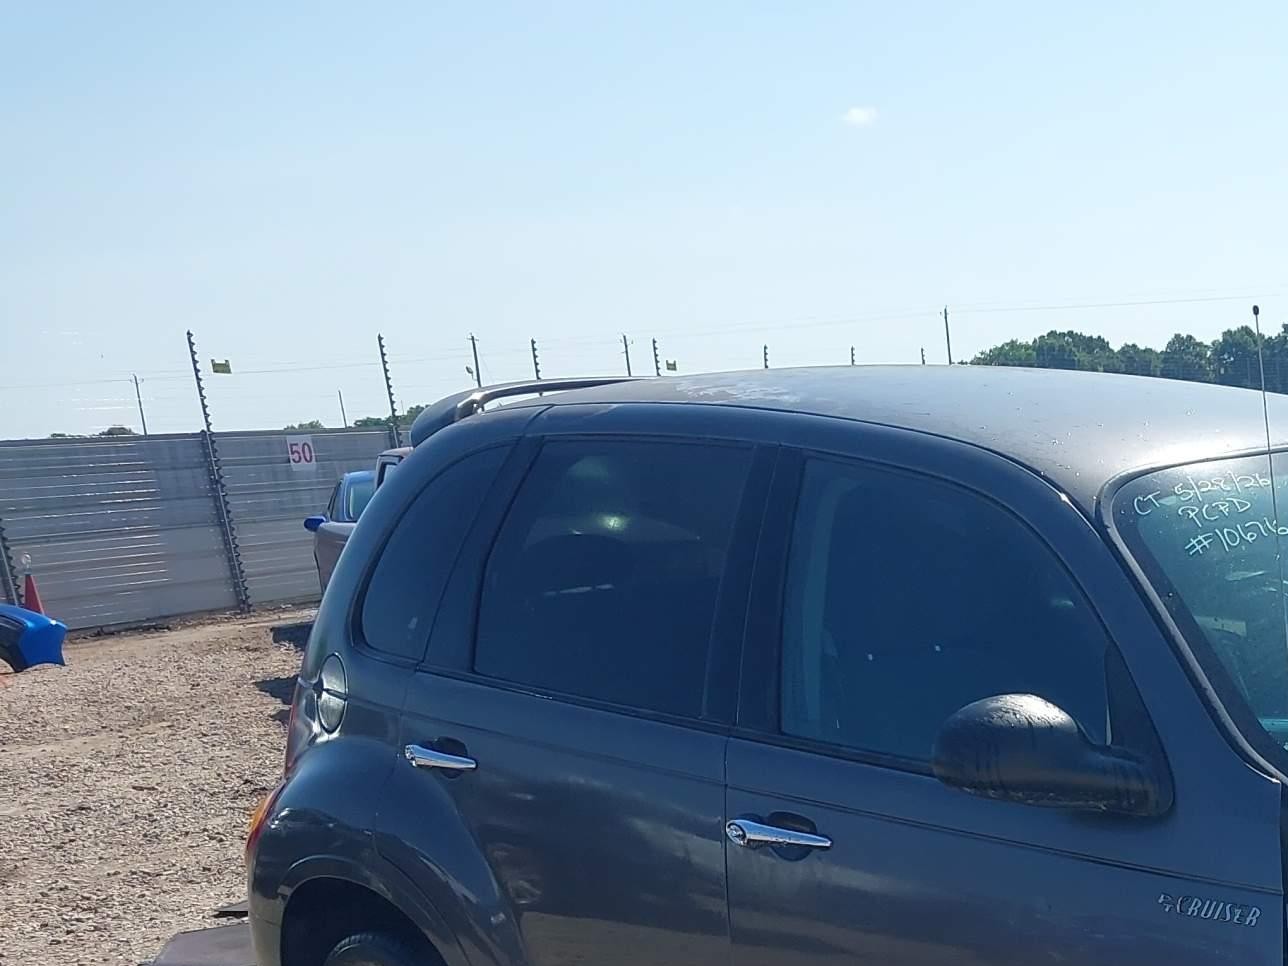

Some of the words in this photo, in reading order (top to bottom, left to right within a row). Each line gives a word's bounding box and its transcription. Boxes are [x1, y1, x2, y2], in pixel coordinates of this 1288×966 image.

[289, 442, 313, 464] 50
[1133, 490, 1161, 515] CT
[1174, 470, 1271, 501] 5/28/26
[1177, 497, 1251, 527] PCPD
[1176, 896, 1262, 926] CRUISER
